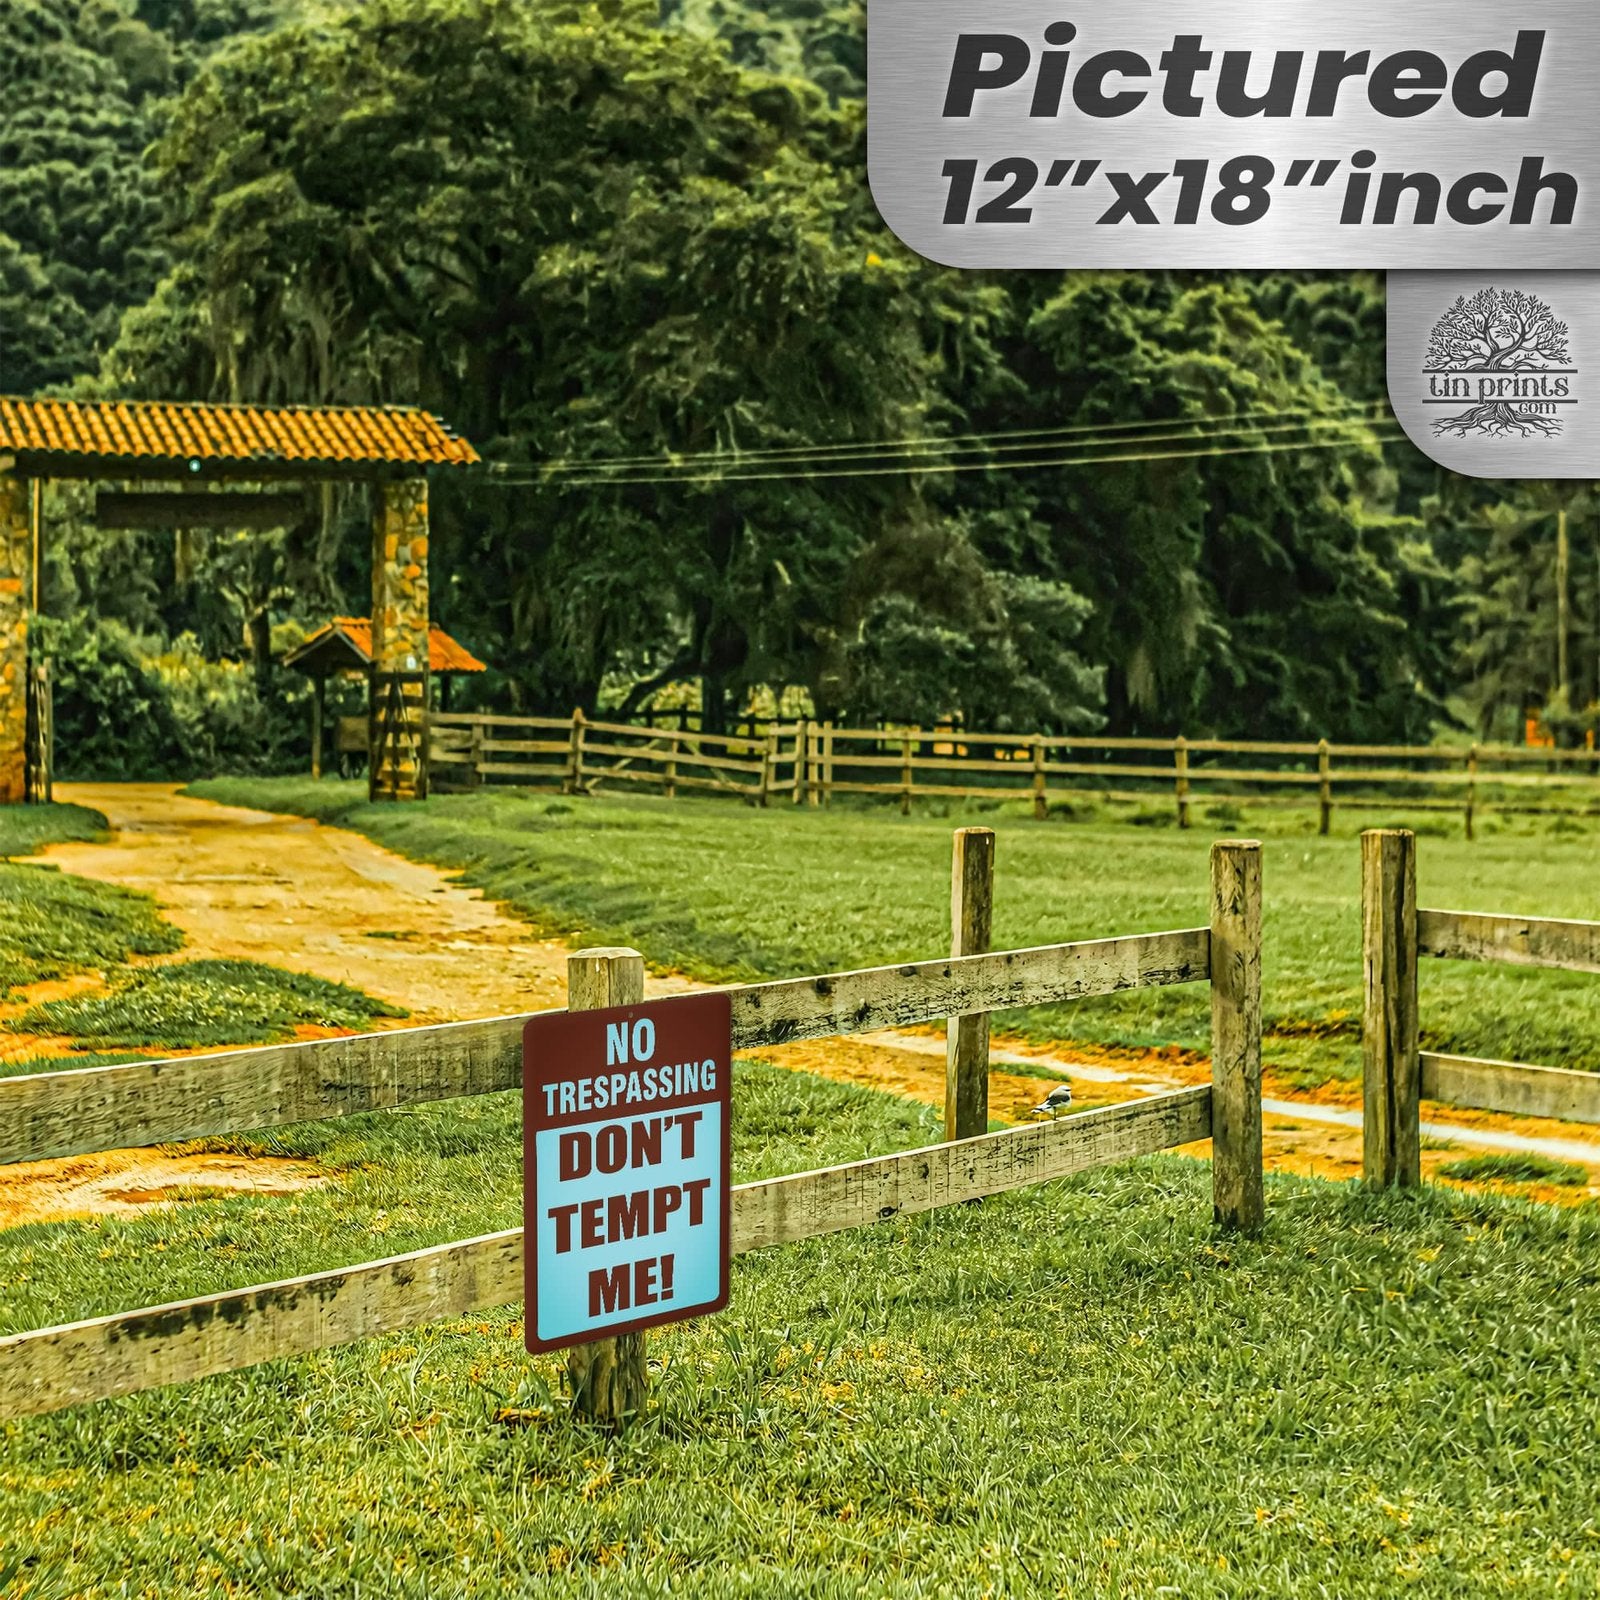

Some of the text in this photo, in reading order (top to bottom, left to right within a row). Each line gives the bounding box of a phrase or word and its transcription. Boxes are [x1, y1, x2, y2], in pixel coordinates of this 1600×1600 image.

[606, 1017, 656, 1066] NO
[542, 1059, 716, 1116] TRESPASSING
[559, 1111, 703, 1182] DON'T
[548, 1178, 711, 1255] TEMPT
[588, 1253, 675, 1318] ME!
